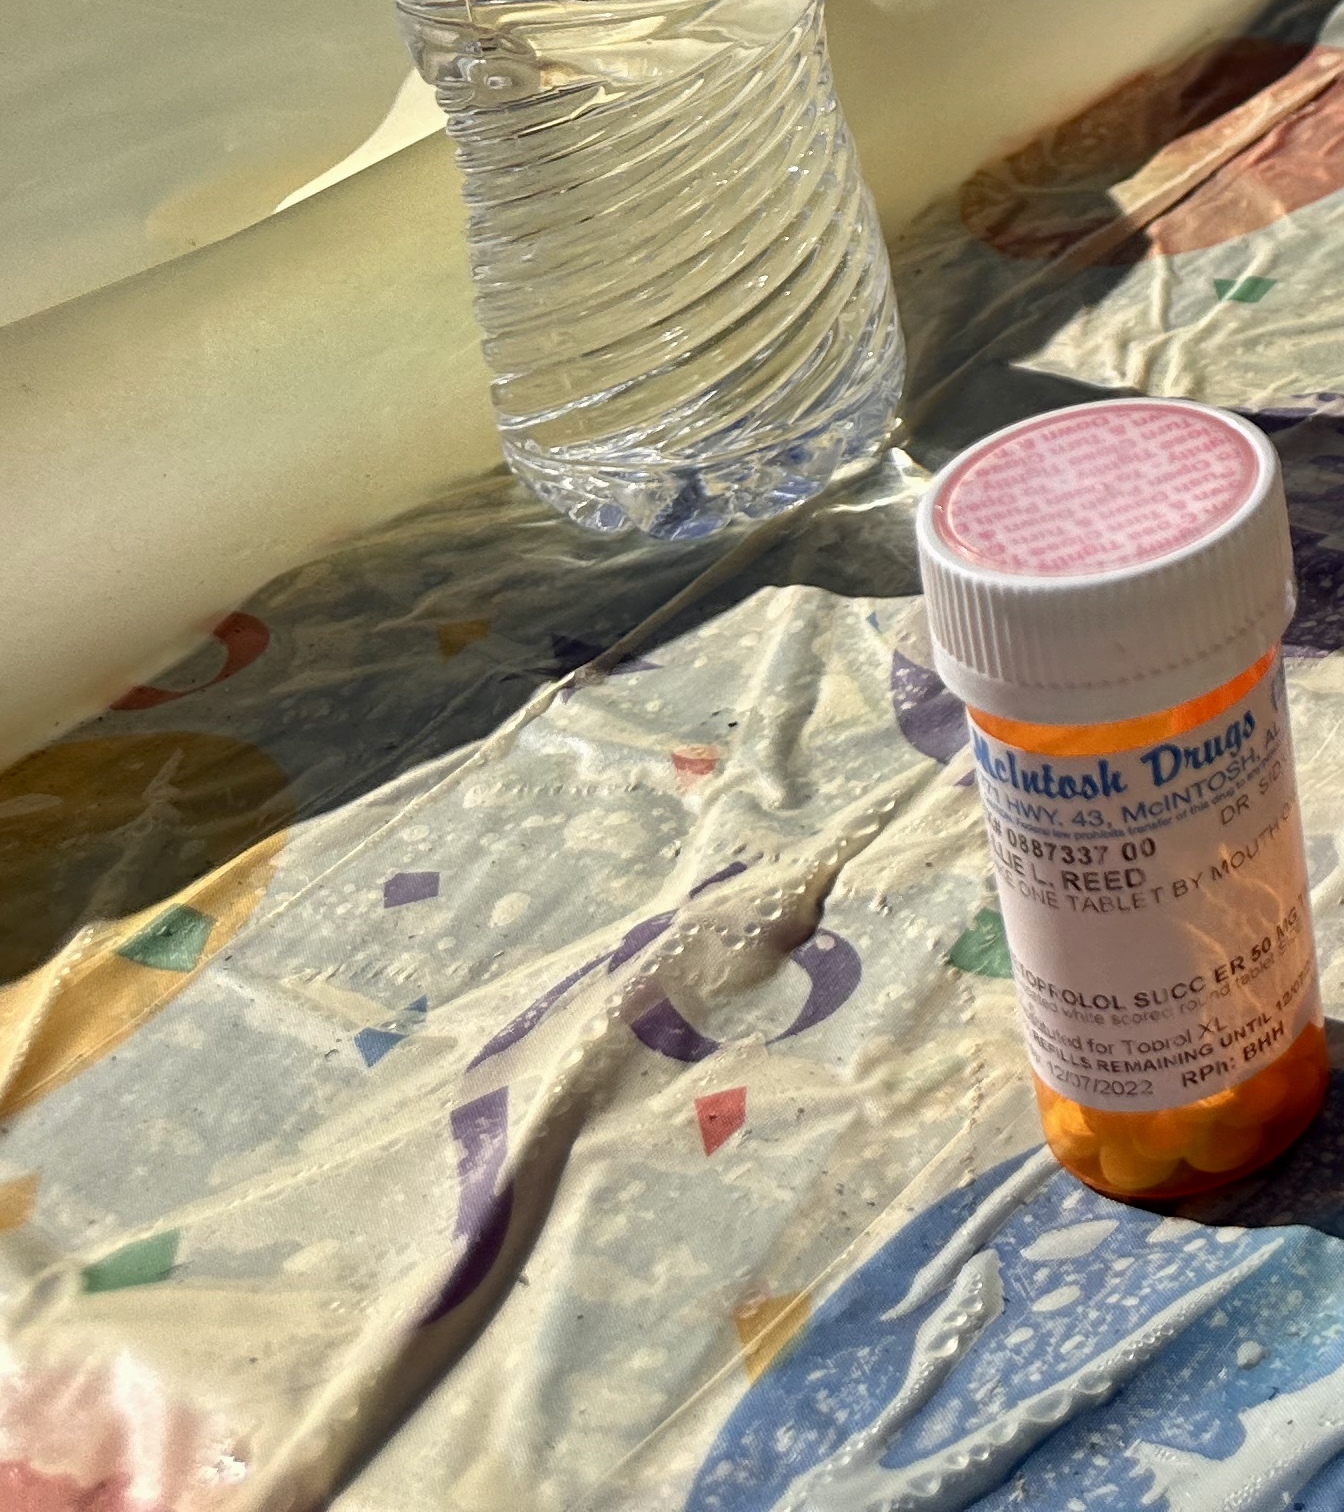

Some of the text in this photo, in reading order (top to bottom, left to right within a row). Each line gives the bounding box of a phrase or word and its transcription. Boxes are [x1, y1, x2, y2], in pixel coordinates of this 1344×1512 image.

[972, 708, 1257, 801] McIntosh Drugs
[1006, 750, 1262, 829] HWY. 43, McINTOSH,
[1007, 829, 1158, 866] 0887337 00
[1019, 819, 1281, 916] ONE TABLET BY MOUTH
[1030, 863, 1147, 893] L. REED
[1133, 906, 1300, 1009] SUCC ER 50 MG
[1061, 1006, 1105, 1025] white
[1088, 1016, 1229, 1056] for Toprol XL
[1097, 1013, 1273, 1073] REMAINING UNTIL
[1181, 1021, 1286, 1089] RPh: BHH
